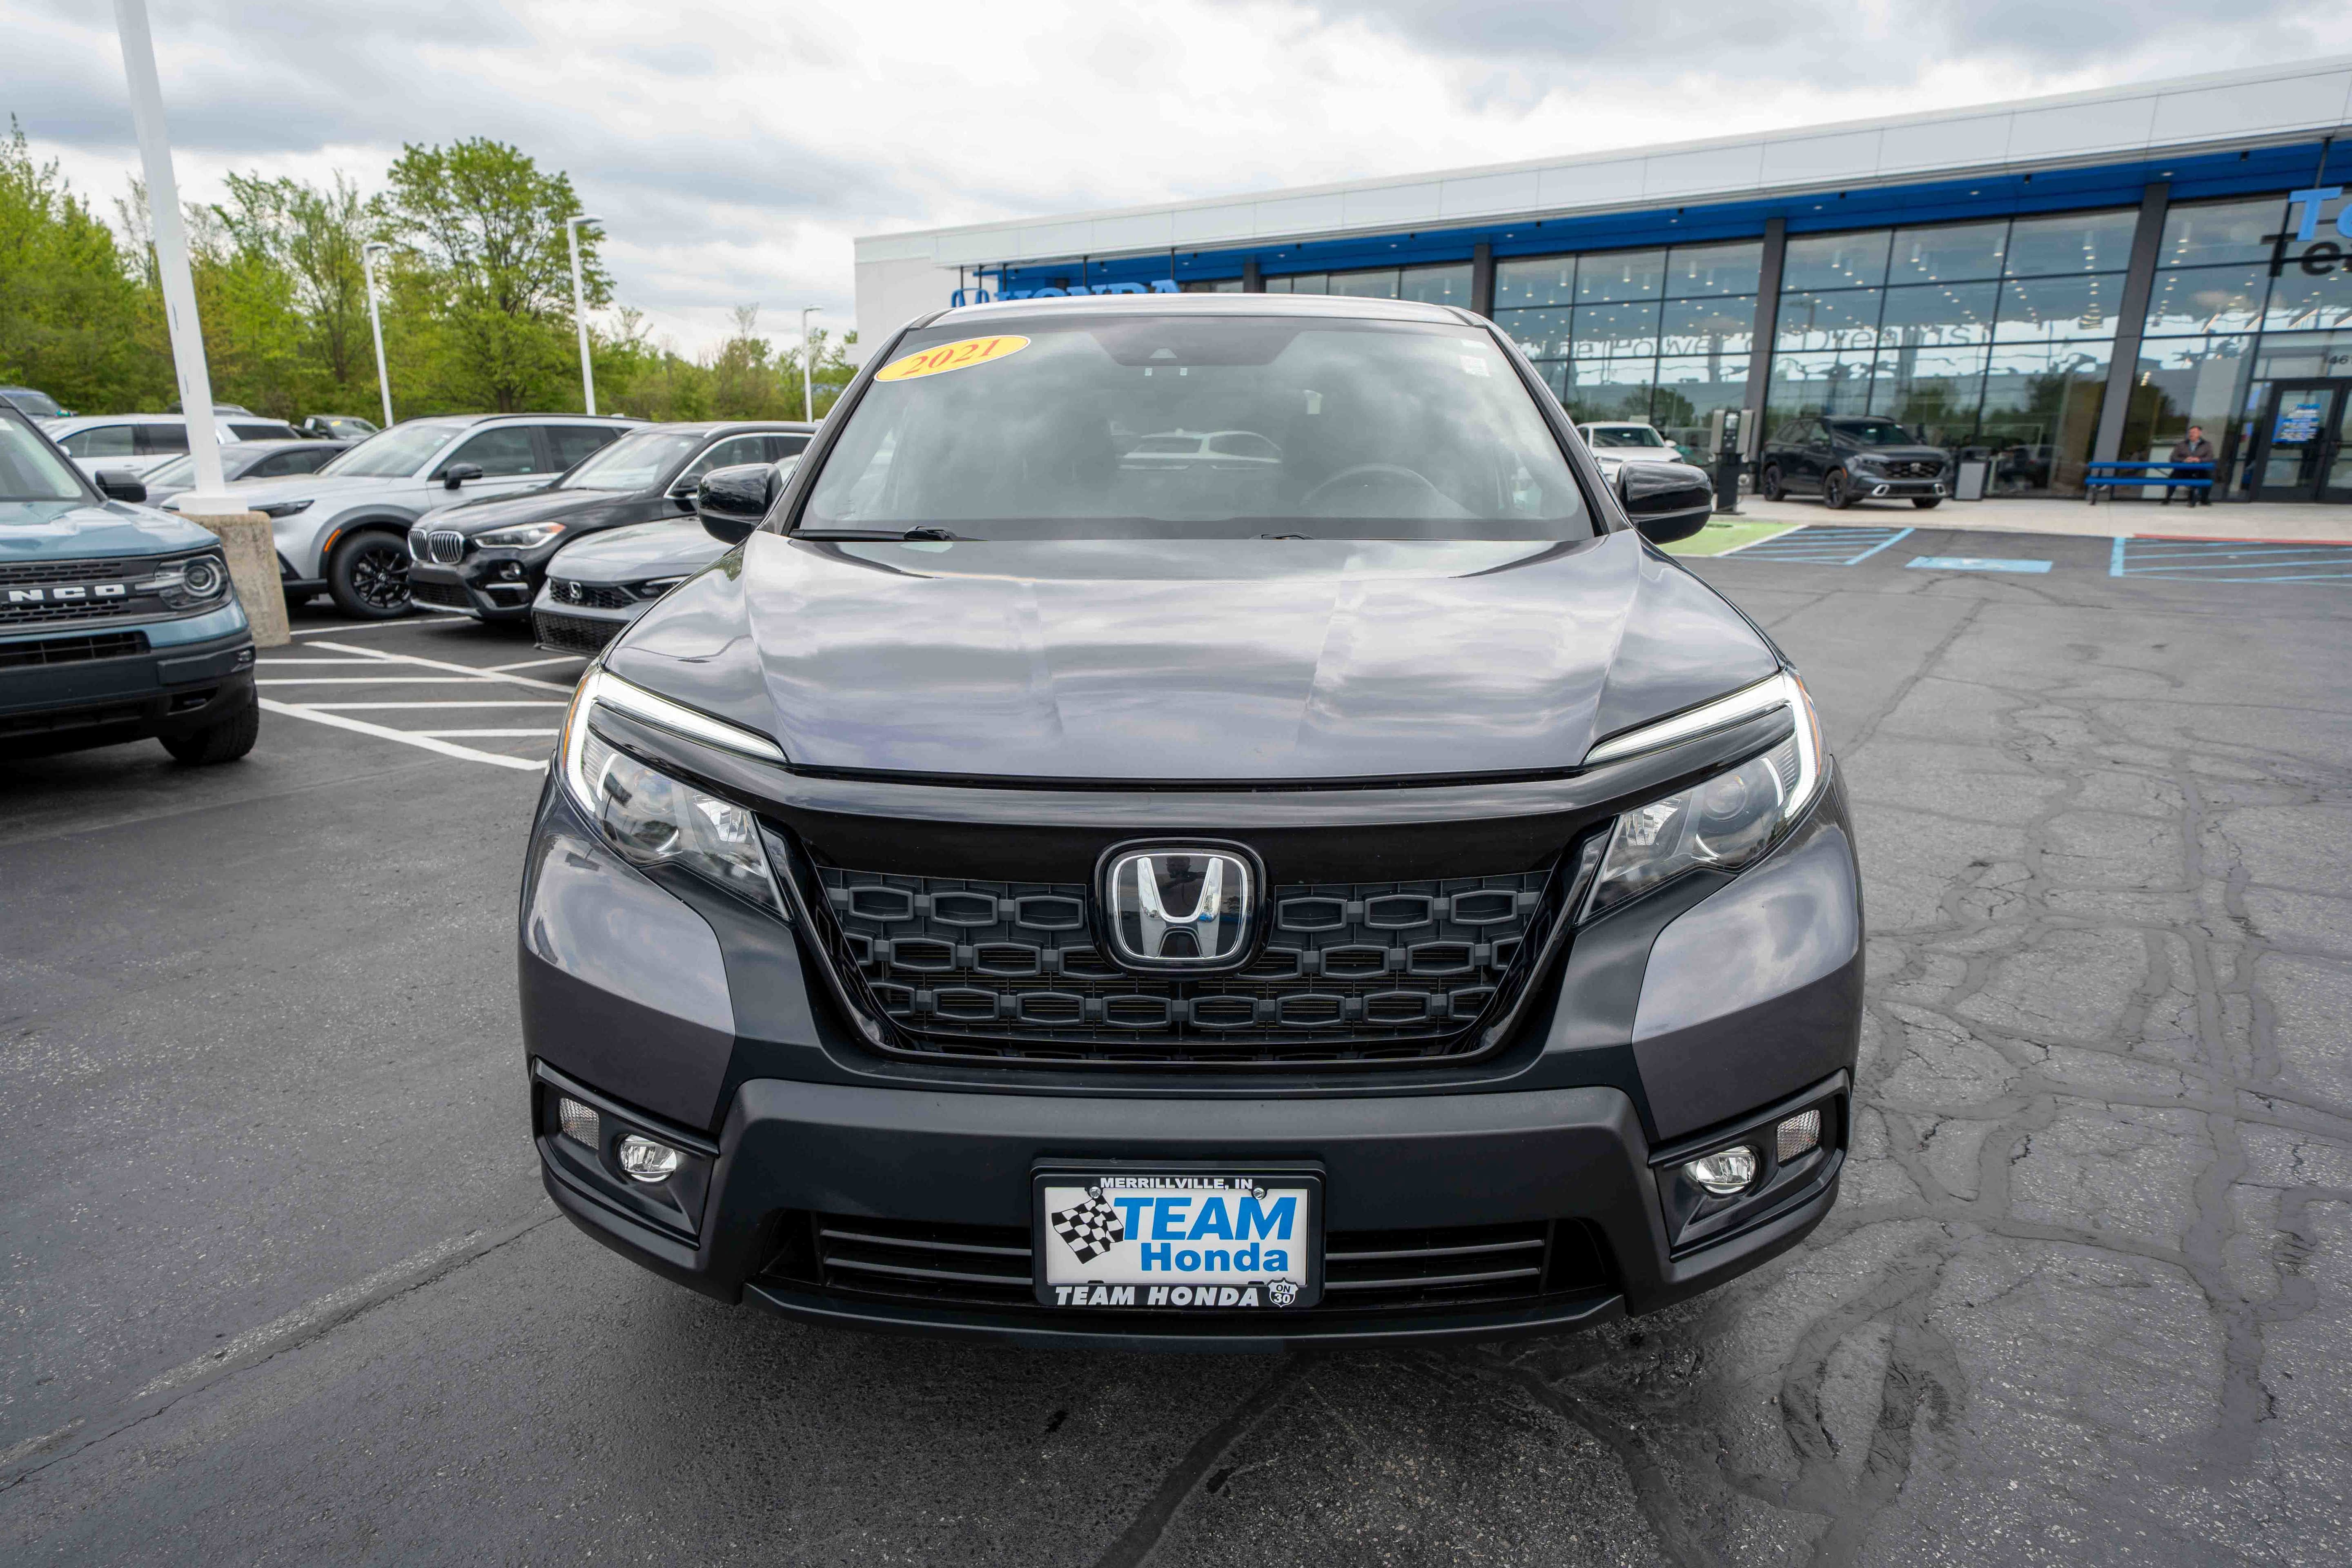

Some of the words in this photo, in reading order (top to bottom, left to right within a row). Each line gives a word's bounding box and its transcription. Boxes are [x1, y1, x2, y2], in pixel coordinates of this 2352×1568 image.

[900, 339, 1000, 376] 2021
[9, 584, 125, 602] NCO
[1100, 1178, 1229, 1191] MERRILLVILLE,
[1235, 1178, 1253, 1189] IN
[1114, 1196, 1296, 1241] TEAM
[1140, 1242, 1289, 1272] Honda
[1056, 1286, 1135, 1305] TEAM
[1147, 1286, 1259, 1307] HONDA
[1274, 1293, 1291, 1303] 30
[1276, 1284, 1291, 1293] ON
